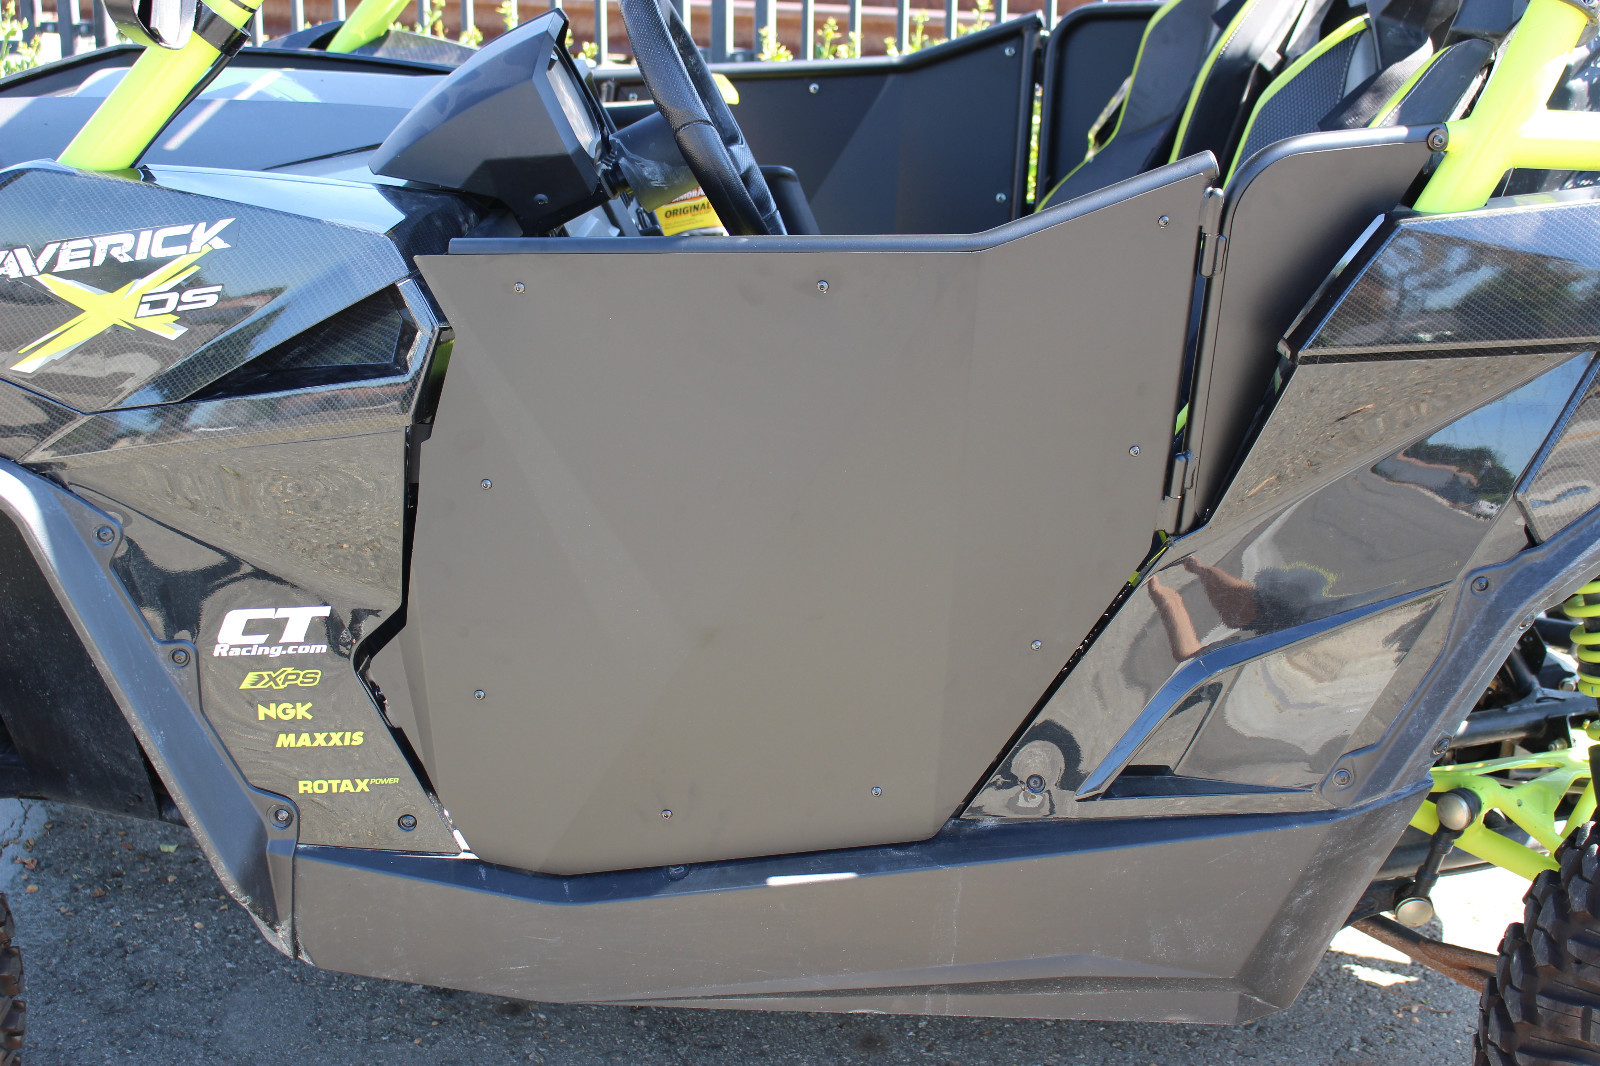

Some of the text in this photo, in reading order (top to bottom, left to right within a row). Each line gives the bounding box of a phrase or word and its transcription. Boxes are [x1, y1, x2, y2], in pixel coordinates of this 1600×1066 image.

[665, 203, 711, 218] ORIGINAL
[218, 605, 331, 644] CT
[213, 643, 328, 657] Racing.com
[257, 702, 313, 721] NGK
[275, 731, 364, 748] MAXXIS
[298, 777, 399, 794] ROTAX POWER
